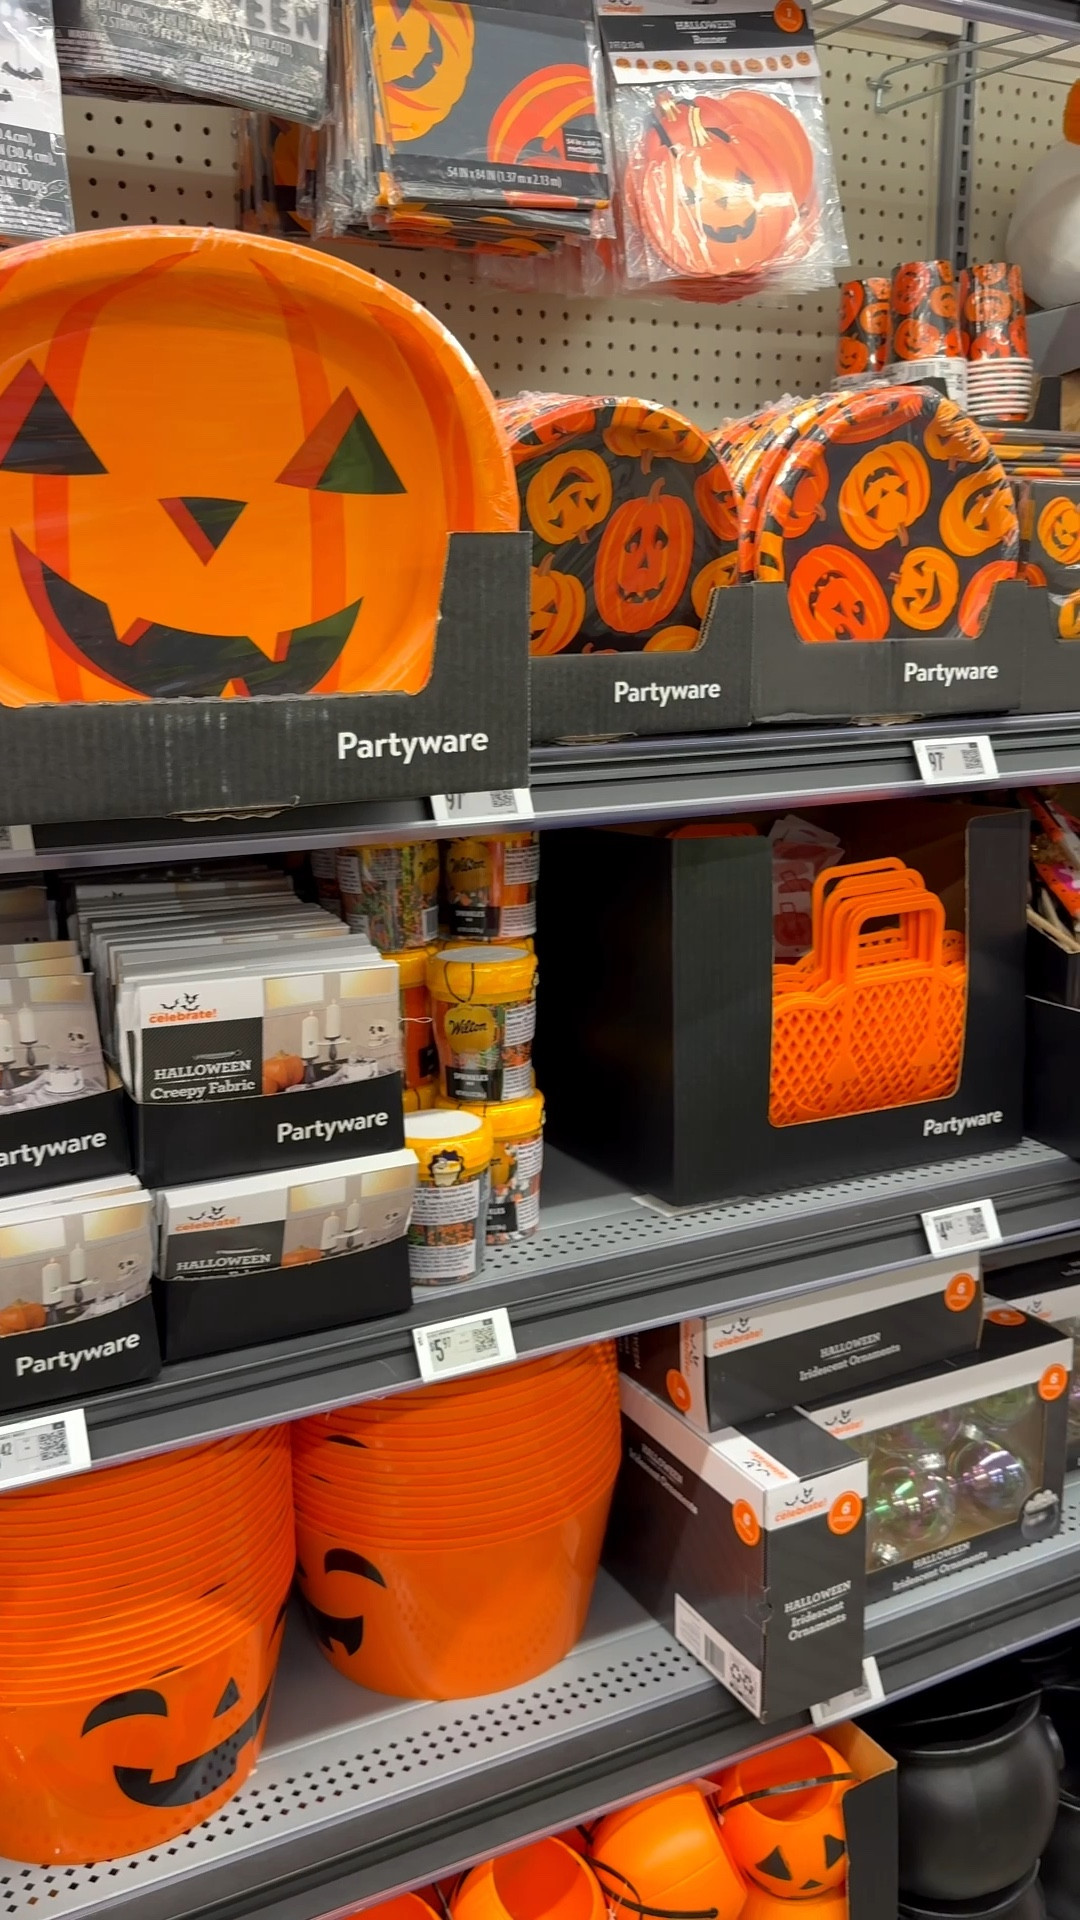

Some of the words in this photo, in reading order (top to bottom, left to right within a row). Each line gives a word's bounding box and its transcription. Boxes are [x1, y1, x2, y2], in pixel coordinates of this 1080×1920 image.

[675, 20, 737, 30] HALLOWEEN
[692, 35, 728, 44] Banner
[447, 166, 458, 177] 54
[458, 167, 468, 178] IN
[475, 169, 486, 180] 84
[487, 170, 496, 181] IN
[497, 171, 516, 183] (1.37
[532, 174, 550, 186] 2.13
[903, 661, 999, 686] Partyware
[613, 680, 722, 707] Partyware
[337, 731, 490, 765] Partyware
[149, 1008, 218, 1024] celebrate!
[448, 1018, 487, 1036] Wilton
[154, 1060, 252, 1080] HALLOWEEN
[150, 1082, 206, 1100] Creepy
[208, 1079, 256, 1096] Fabric
[276, 1111, 390, 1143] Partyware
[922, 1110, 1004, 1137] Partyware
[0, 1131, 107, 1167] artyware
[175, 1216, 242, 1232] celebrate!
[176, 1253, 272, 1271] HALLOWEEN
[956, 1282, 966, 1294] 6
[15, 1333, 141, 1377] Partyware
[819, 1332, 882, 1358] HALLOWEEN
[799, 1358, 849, 1382] Iridescent
[849, 1344, 901, 1366] Ornaments
[1050, 1374, 1059, 1385] 6
[774, 1497, 828, 1523] celebrate!
[840, 1501, 851, 1515] 6
[912, 1541, 971, 1569] HALLOWEEN
[892, 1568, 939, 1592] Iridescent
[939, 1551, 989, 1574] Ornaments
[784, 1580, 852, 1613] HALLOWEEN
[788, 1613, 847, 1641] Ornaments
[791, 1601, 844, 1628] Iridescent
